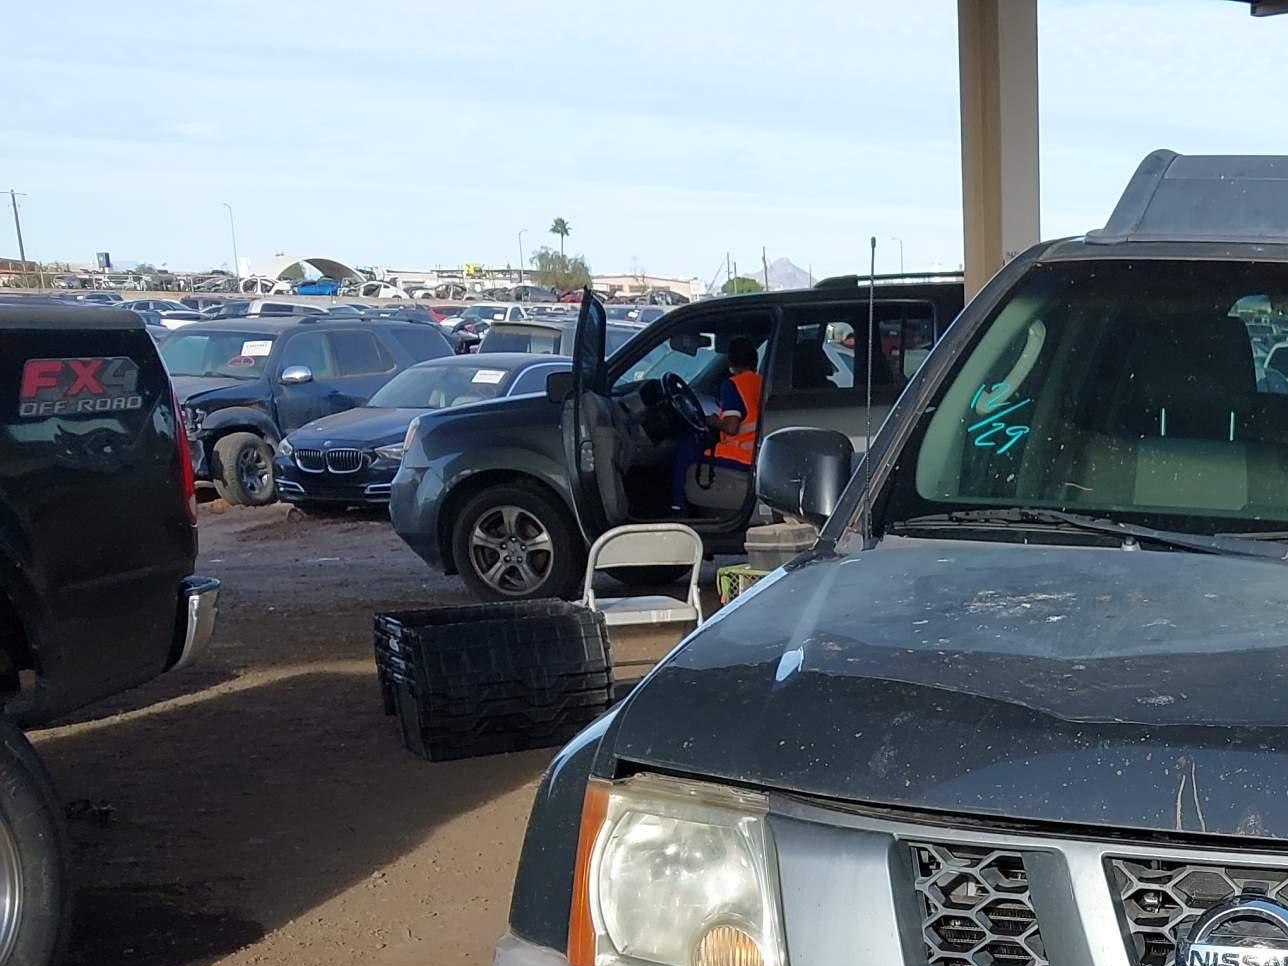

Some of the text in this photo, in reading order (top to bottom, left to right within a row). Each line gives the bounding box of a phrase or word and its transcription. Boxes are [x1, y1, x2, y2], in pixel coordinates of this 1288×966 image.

[22, 358, 138, 399] FX4
[20, 396, 143, 416] OFF ROAD
